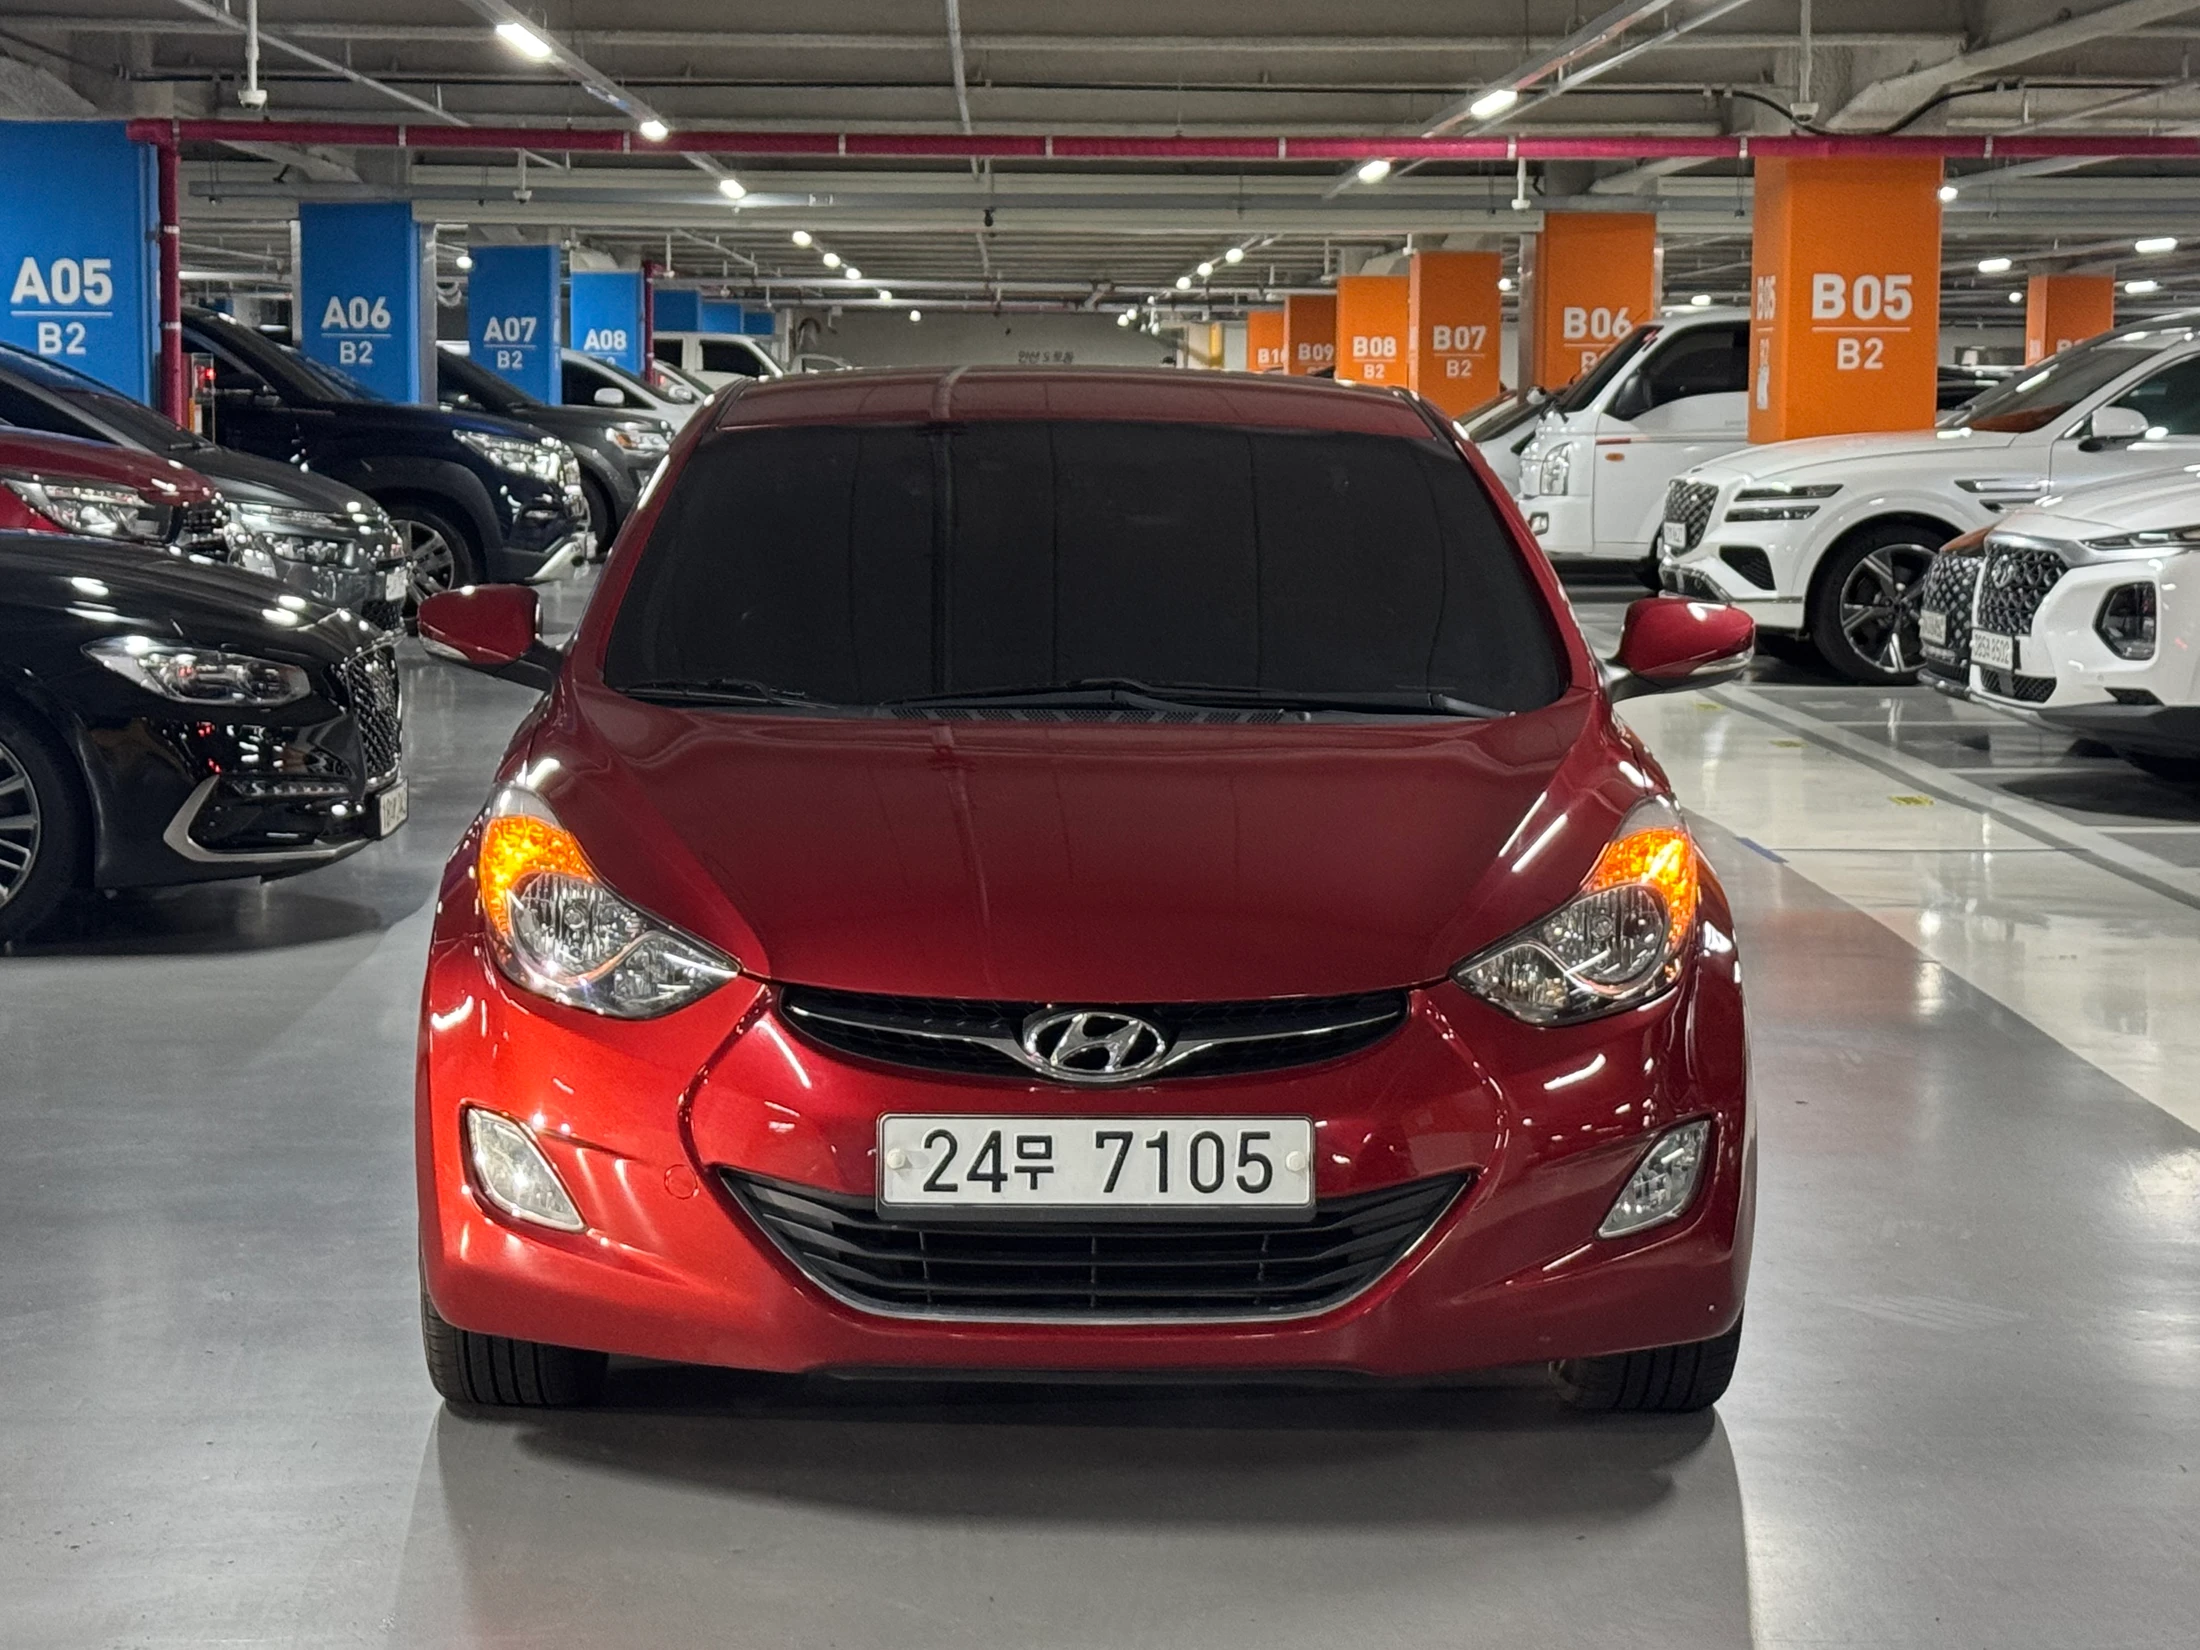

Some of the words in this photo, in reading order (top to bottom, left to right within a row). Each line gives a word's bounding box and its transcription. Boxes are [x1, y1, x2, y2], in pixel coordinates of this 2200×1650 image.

[11, 257, 113, 305] A05
[1811, 273, 1913, 320] B05
[321, 296, 391, 330] A06
[1563, 306, 1634, 339] B06
[37, 321, 86, 355] B2
[483, 316, 536, 344] A07
[583, 328, 627, 351] A08
[1433, 325, 1487, 351] B07
[339, 341, 373, 365] B2
[496, 349, 523, 369] B2
[1298, 343, 1334, 361] B09
[1352, 336, 1397, 358] B08
[1837, 338, 1884, 370] B2
[1363, 363, 1385, 379] B2
[1446, 359, 1473, 378] B2
[923, 1129, 1054, 1193] 24무
[1095, 1130, 1273, 1194] 7105
